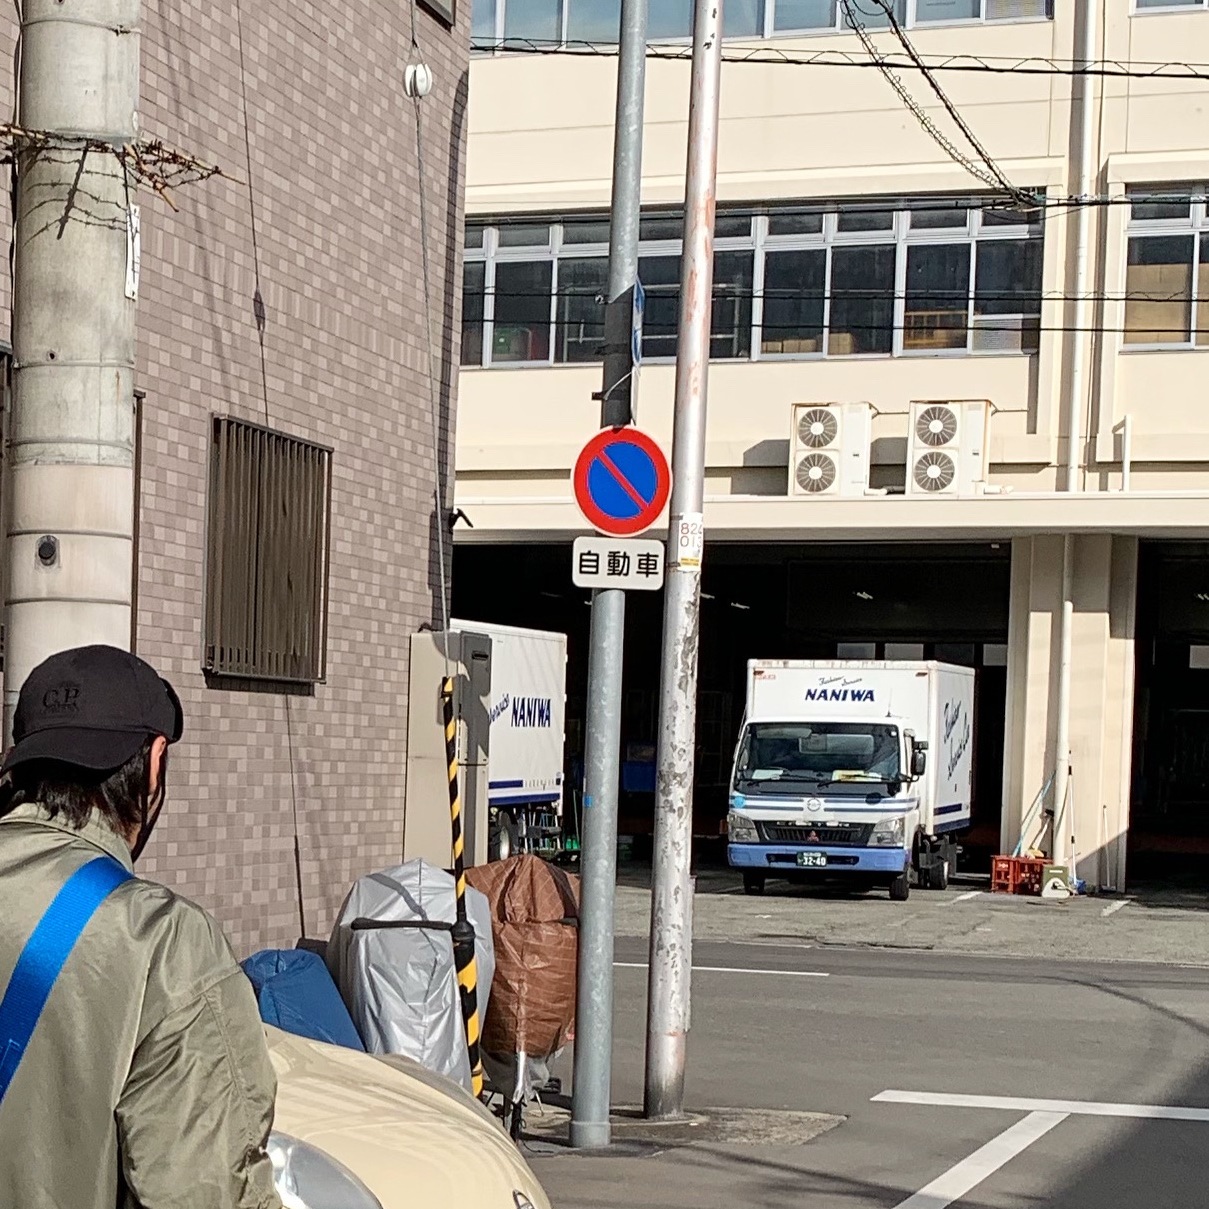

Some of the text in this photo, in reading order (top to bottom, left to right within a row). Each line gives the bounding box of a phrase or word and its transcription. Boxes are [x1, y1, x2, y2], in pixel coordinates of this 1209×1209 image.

[579, 550, 659, 578] 自動車
[804, 688, 875, 702] NANIWA
[511, 696, 551, 728] NANIWA
